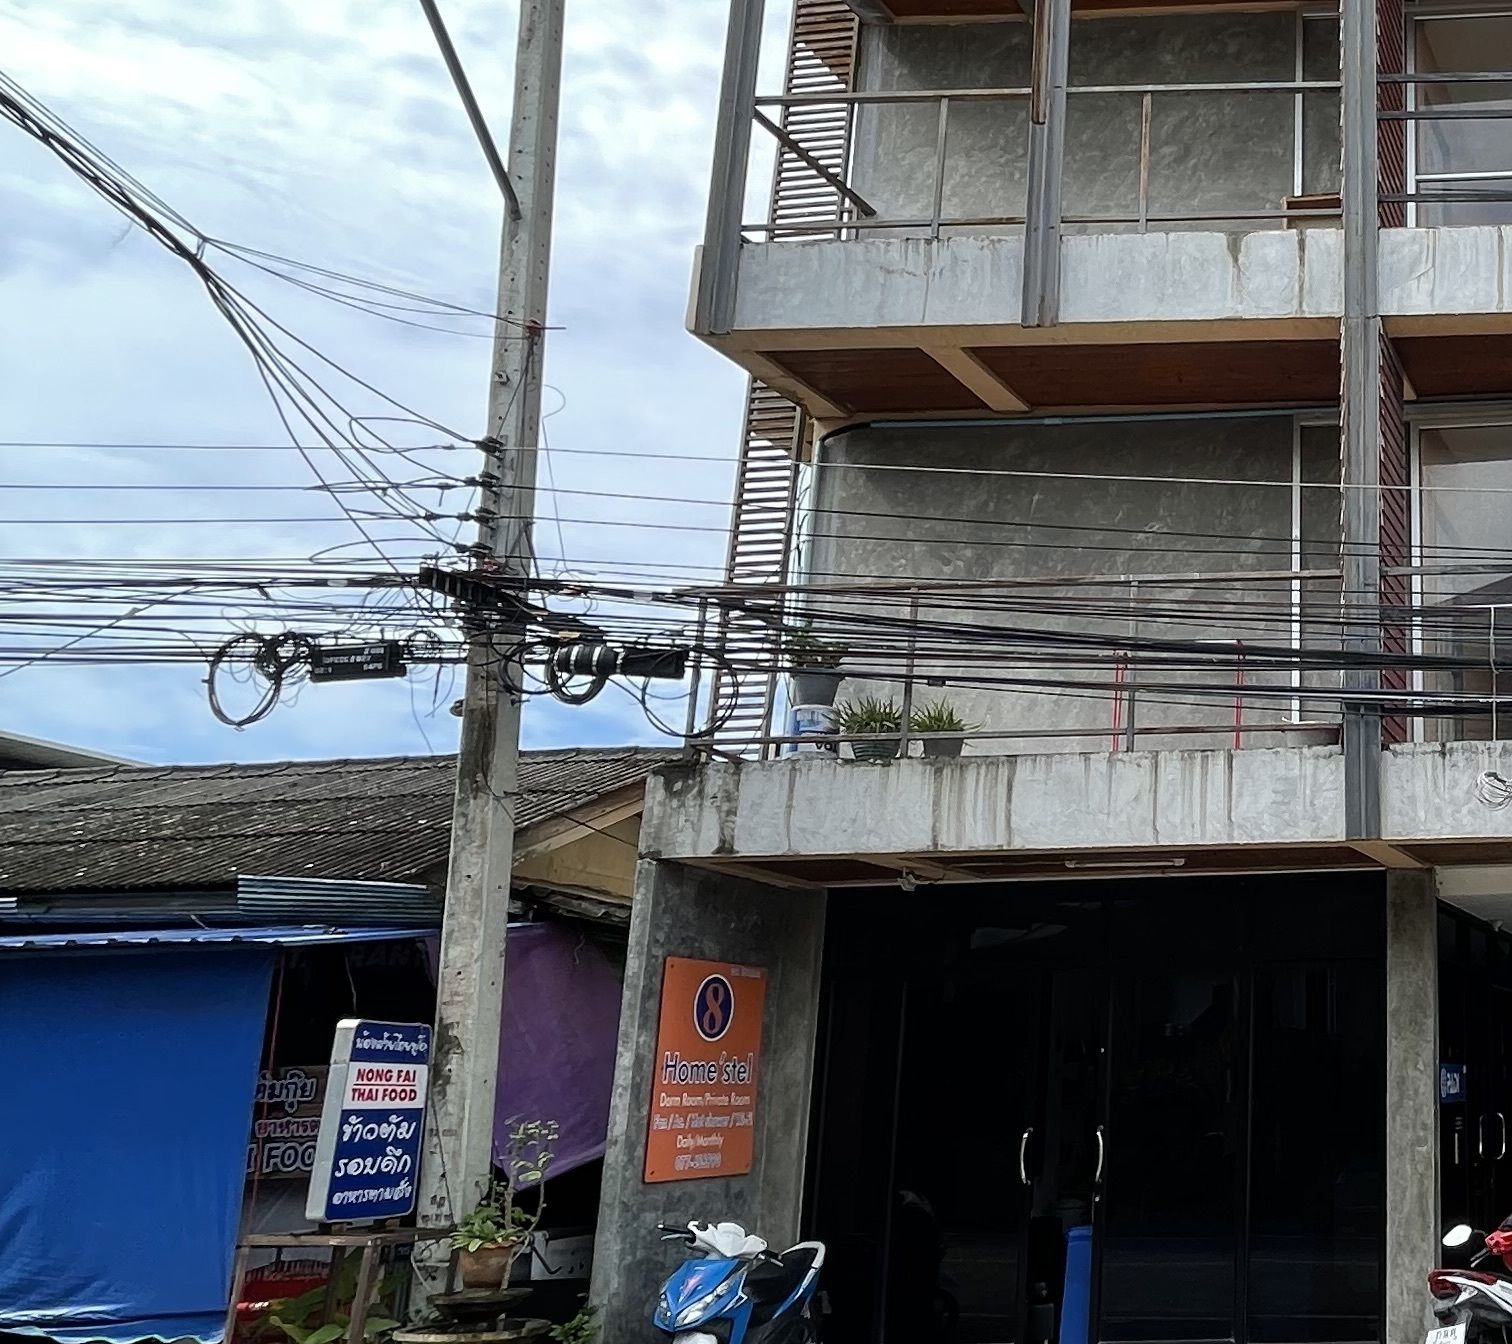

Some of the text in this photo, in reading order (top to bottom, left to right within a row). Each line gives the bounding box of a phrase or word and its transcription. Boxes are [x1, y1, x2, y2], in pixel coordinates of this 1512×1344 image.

[356, 1068, 417, 1083] NONG FAI
[351, 1088, 417, 1102] THAI FOOD
[342, 1114, 417, 1142] ข้าวต้ม
[262, 1141, 316, 1173] FOO
[334, 1145, 412, 1177] รอบดึก
